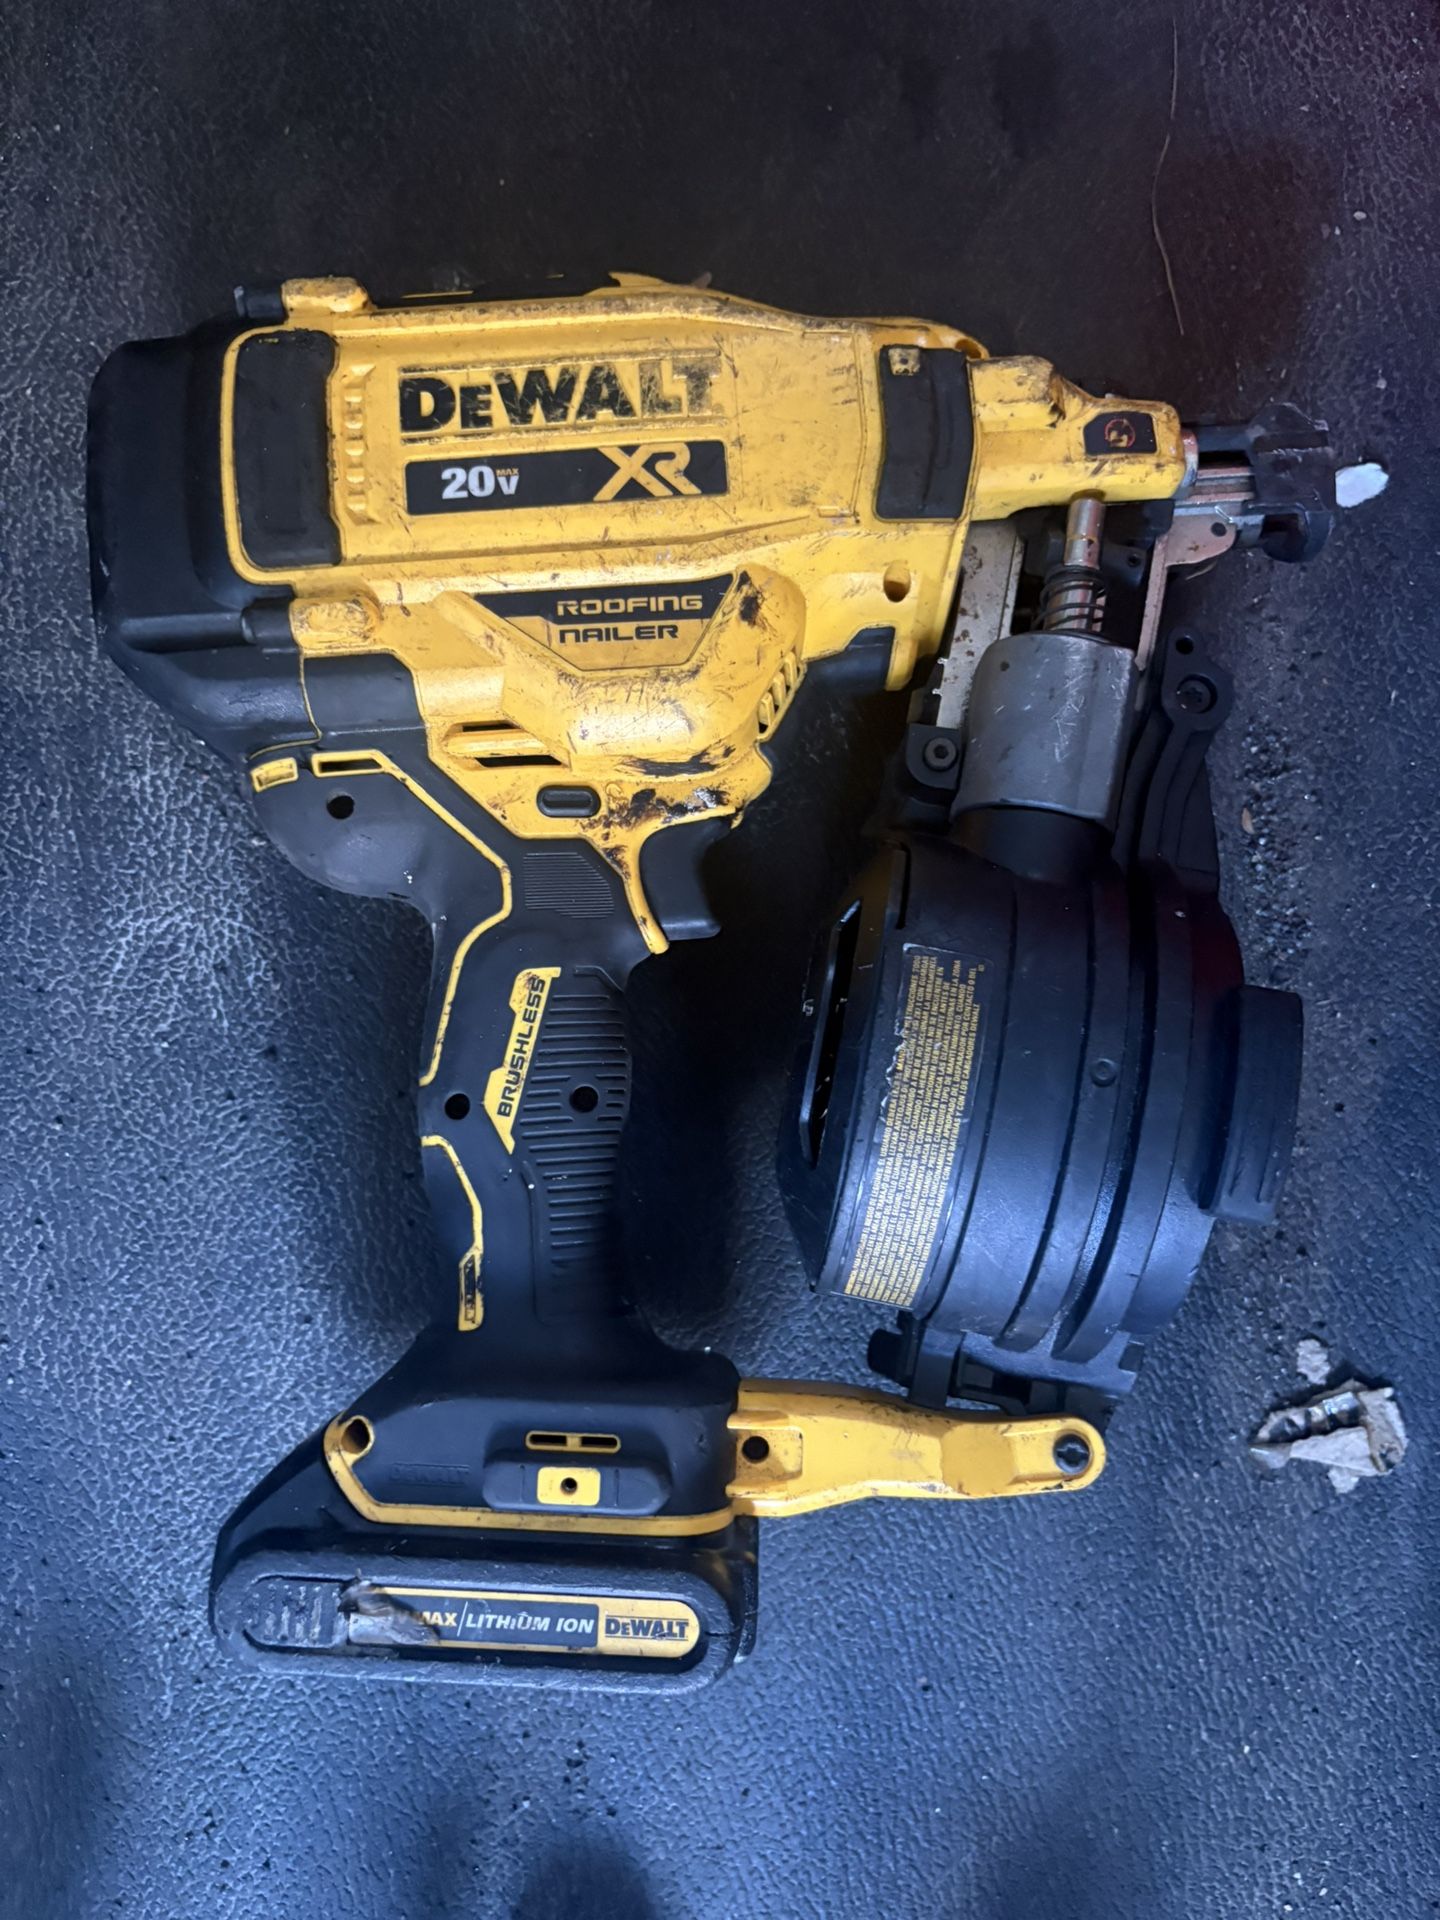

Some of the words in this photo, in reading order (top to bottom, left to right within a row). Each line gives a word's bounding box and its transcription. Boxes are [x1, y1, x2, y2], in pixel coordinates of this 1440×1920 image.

[400, 357, 719, 432] DEWALT
[593, 442, 702, 501] XR
[557, 595, 702, 616] ROOFING
[559, 625, 679, 644] NAILER
[496, 974, 545, 1117] BRUSHLESS
[556, 1618, 594, 1633] ION
[605, 1618, 688, 1637] DEWALT
